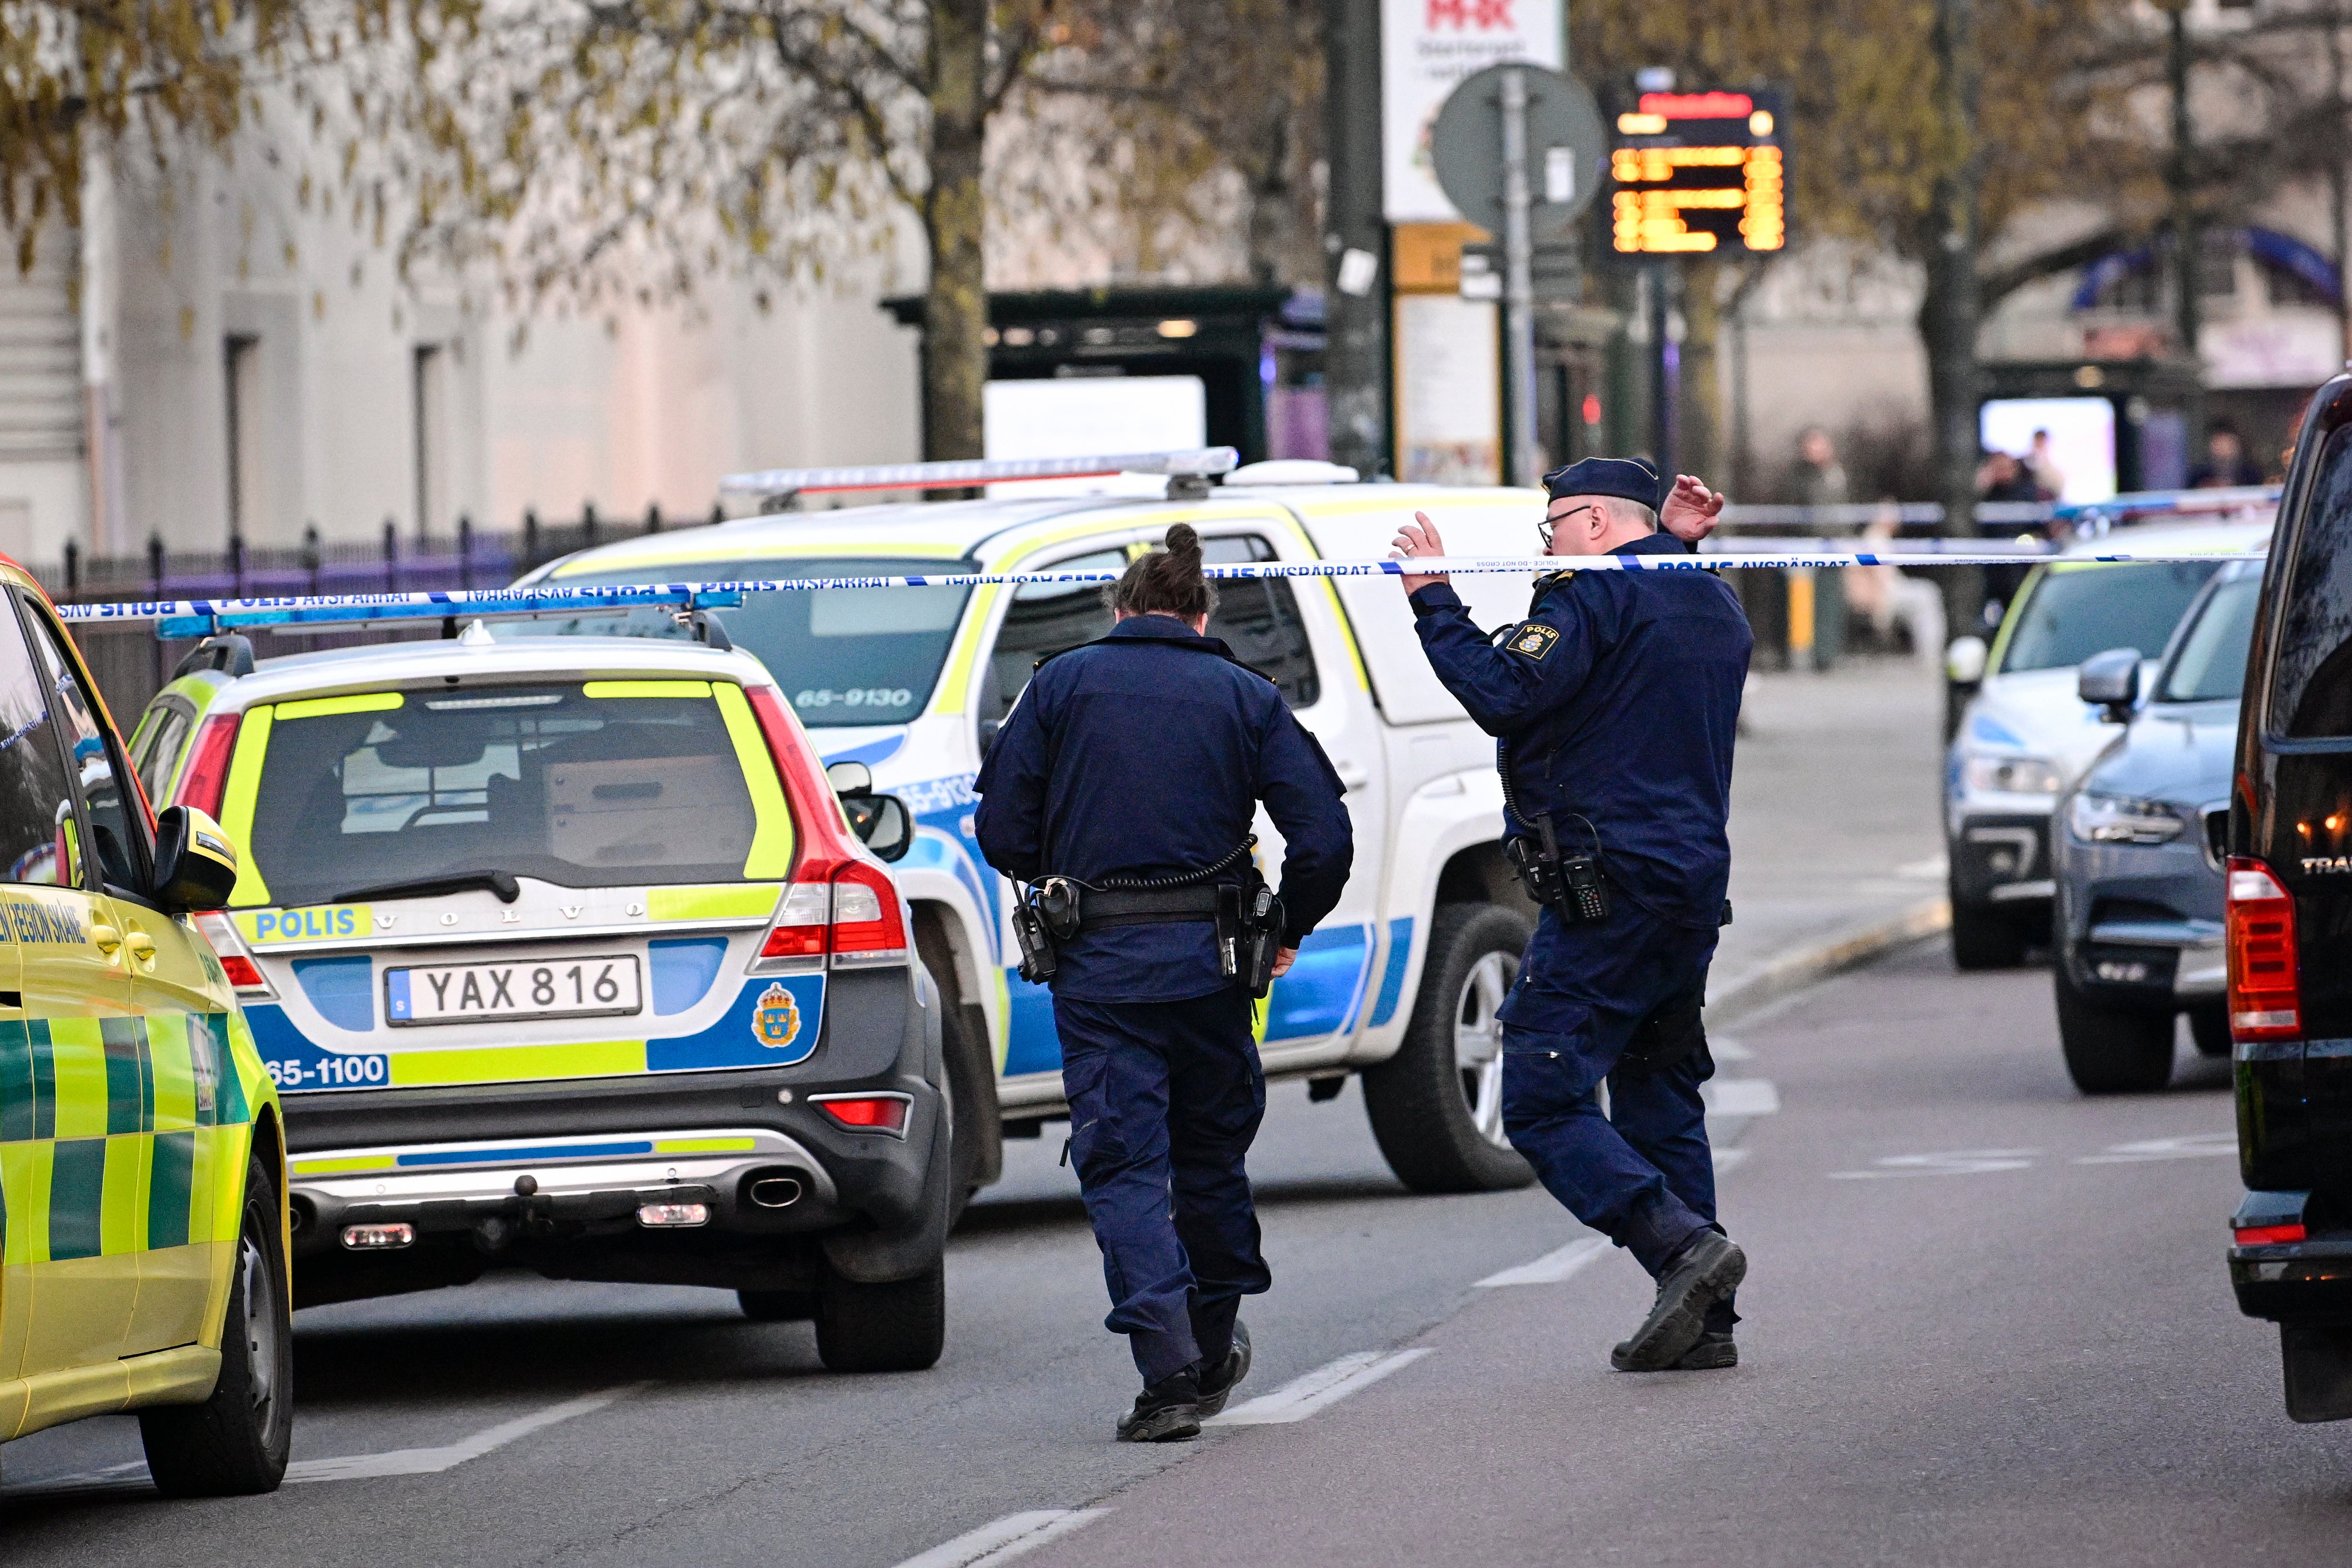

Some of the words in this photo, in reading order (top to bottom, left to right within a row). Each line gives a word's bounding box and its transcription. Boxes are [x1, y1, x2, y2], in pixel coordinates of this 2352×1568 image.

[1202, 568, 1255, 578] OLIS
[701, 581, 776, 593] POLIS
[58, 604, 93, 618] AVS
[100, 601, 176, 617] POLIS
[1527, 626, 1556, 638] POLIS
[795, 688, 912, 708] 65-9130
[2300, 856, 2352, 874] TRA
[256, 909, 355, 939] POLIS
[373, 902, 645, 929] VOLVO
[427, 969, 514, 1011] YAX
[531, 964, 619, 1006] 816
[396, 1000, 405, 1011] S
[266, 1055, 384, 1086] 65-1100
